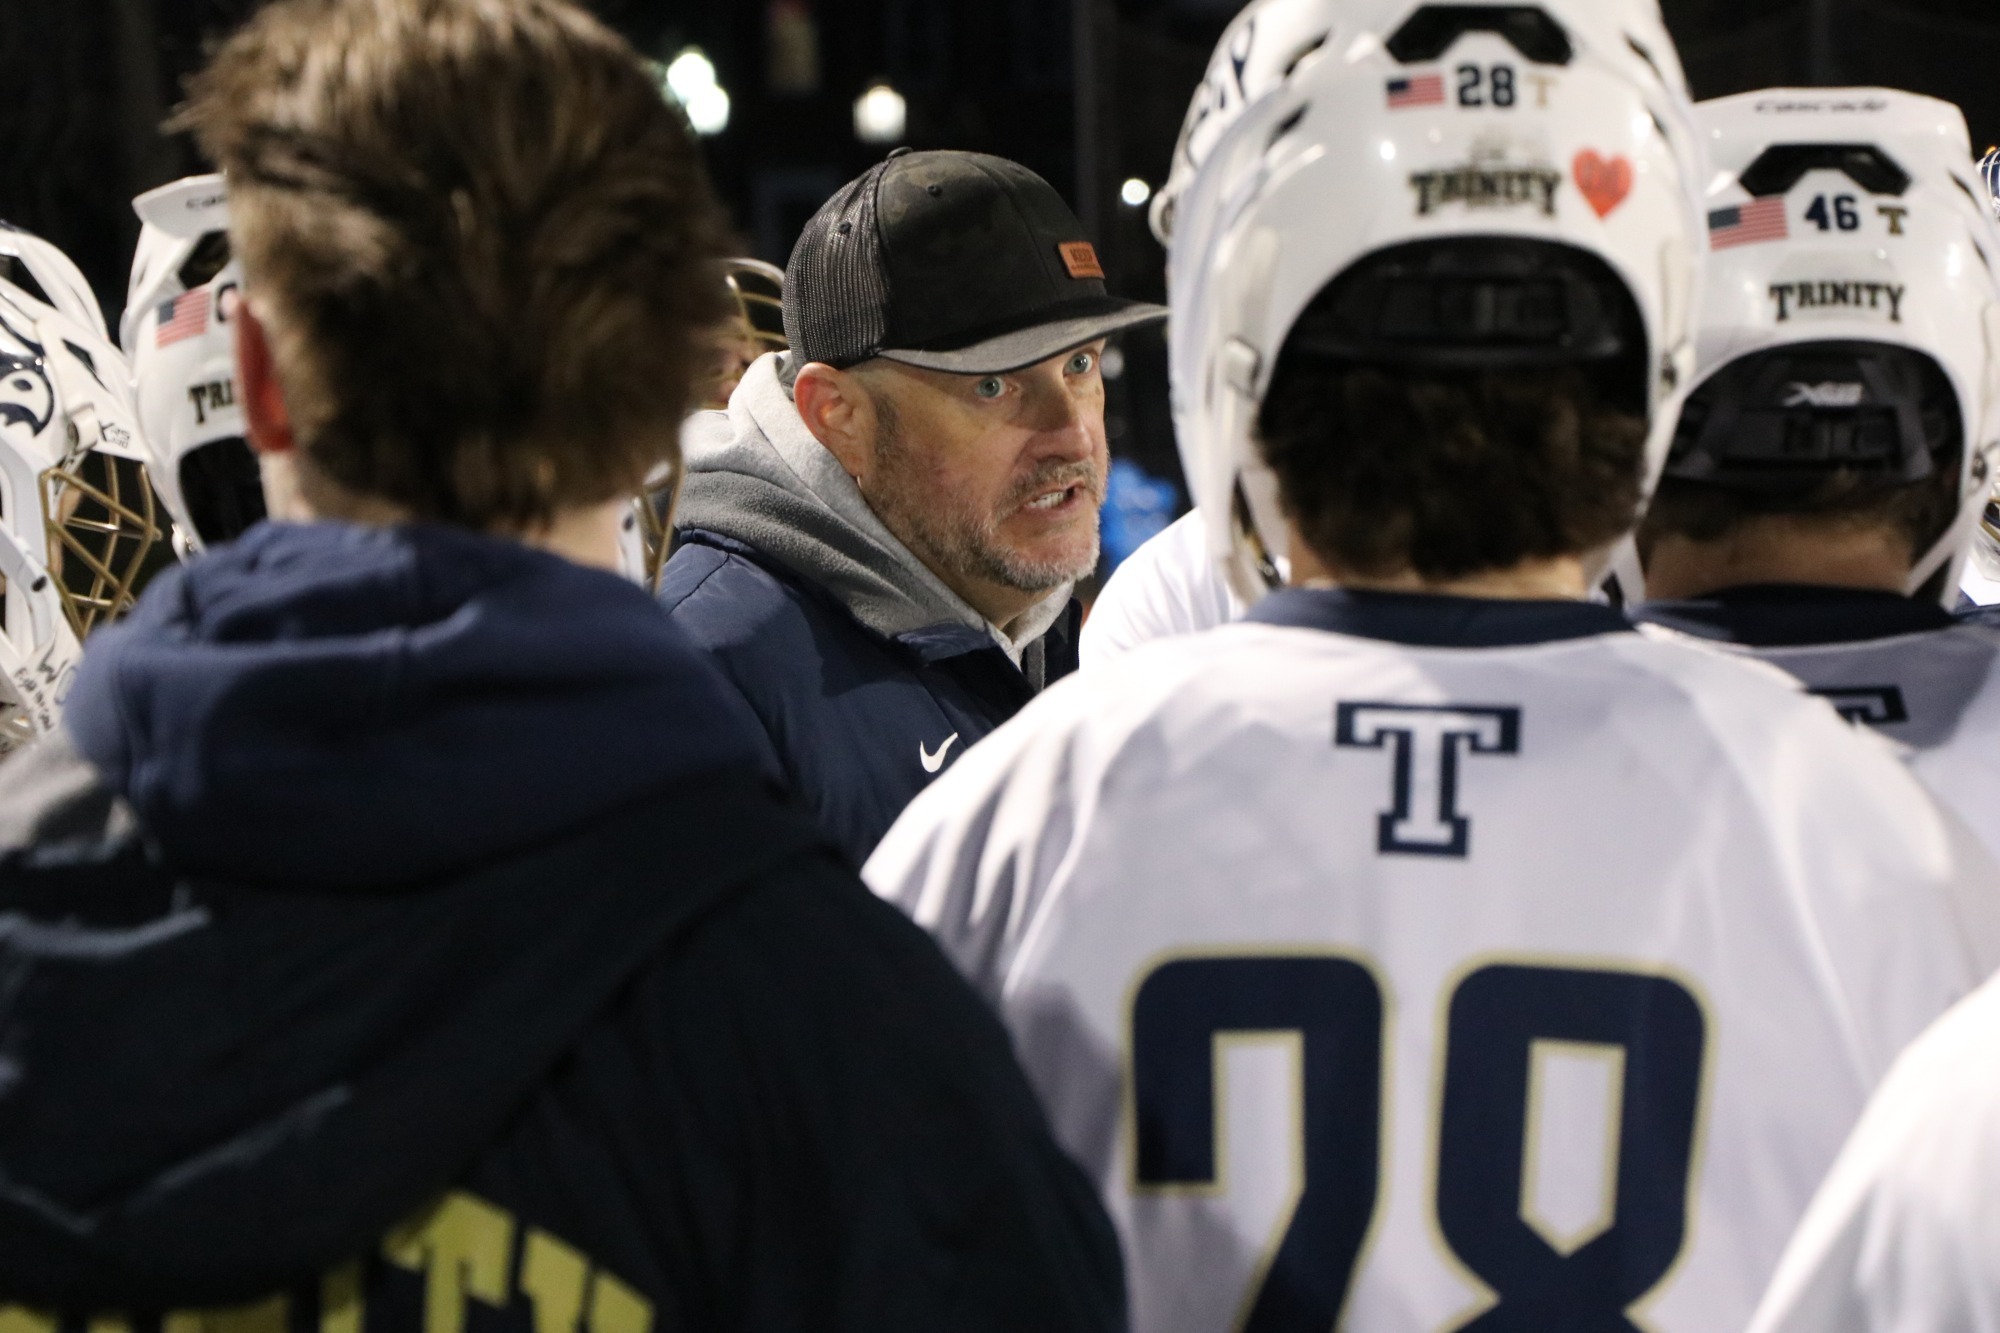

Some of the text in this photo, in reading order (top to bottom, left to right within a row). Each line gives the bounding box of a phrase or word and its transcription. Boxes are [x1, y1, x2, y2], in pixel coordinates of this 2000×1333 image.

[1457, 64, 1557, 107] 28 T
[1409, 165, 1562, 219] TRINITY
[1804, 193, 1908, 235] 46 T
[1769, 280, 1906, 325] TRINITY
[189, 379, 235, 426] TRI
[1334, 700, 1522, 859] T
[1126, 943, 1717, 1333] 28
